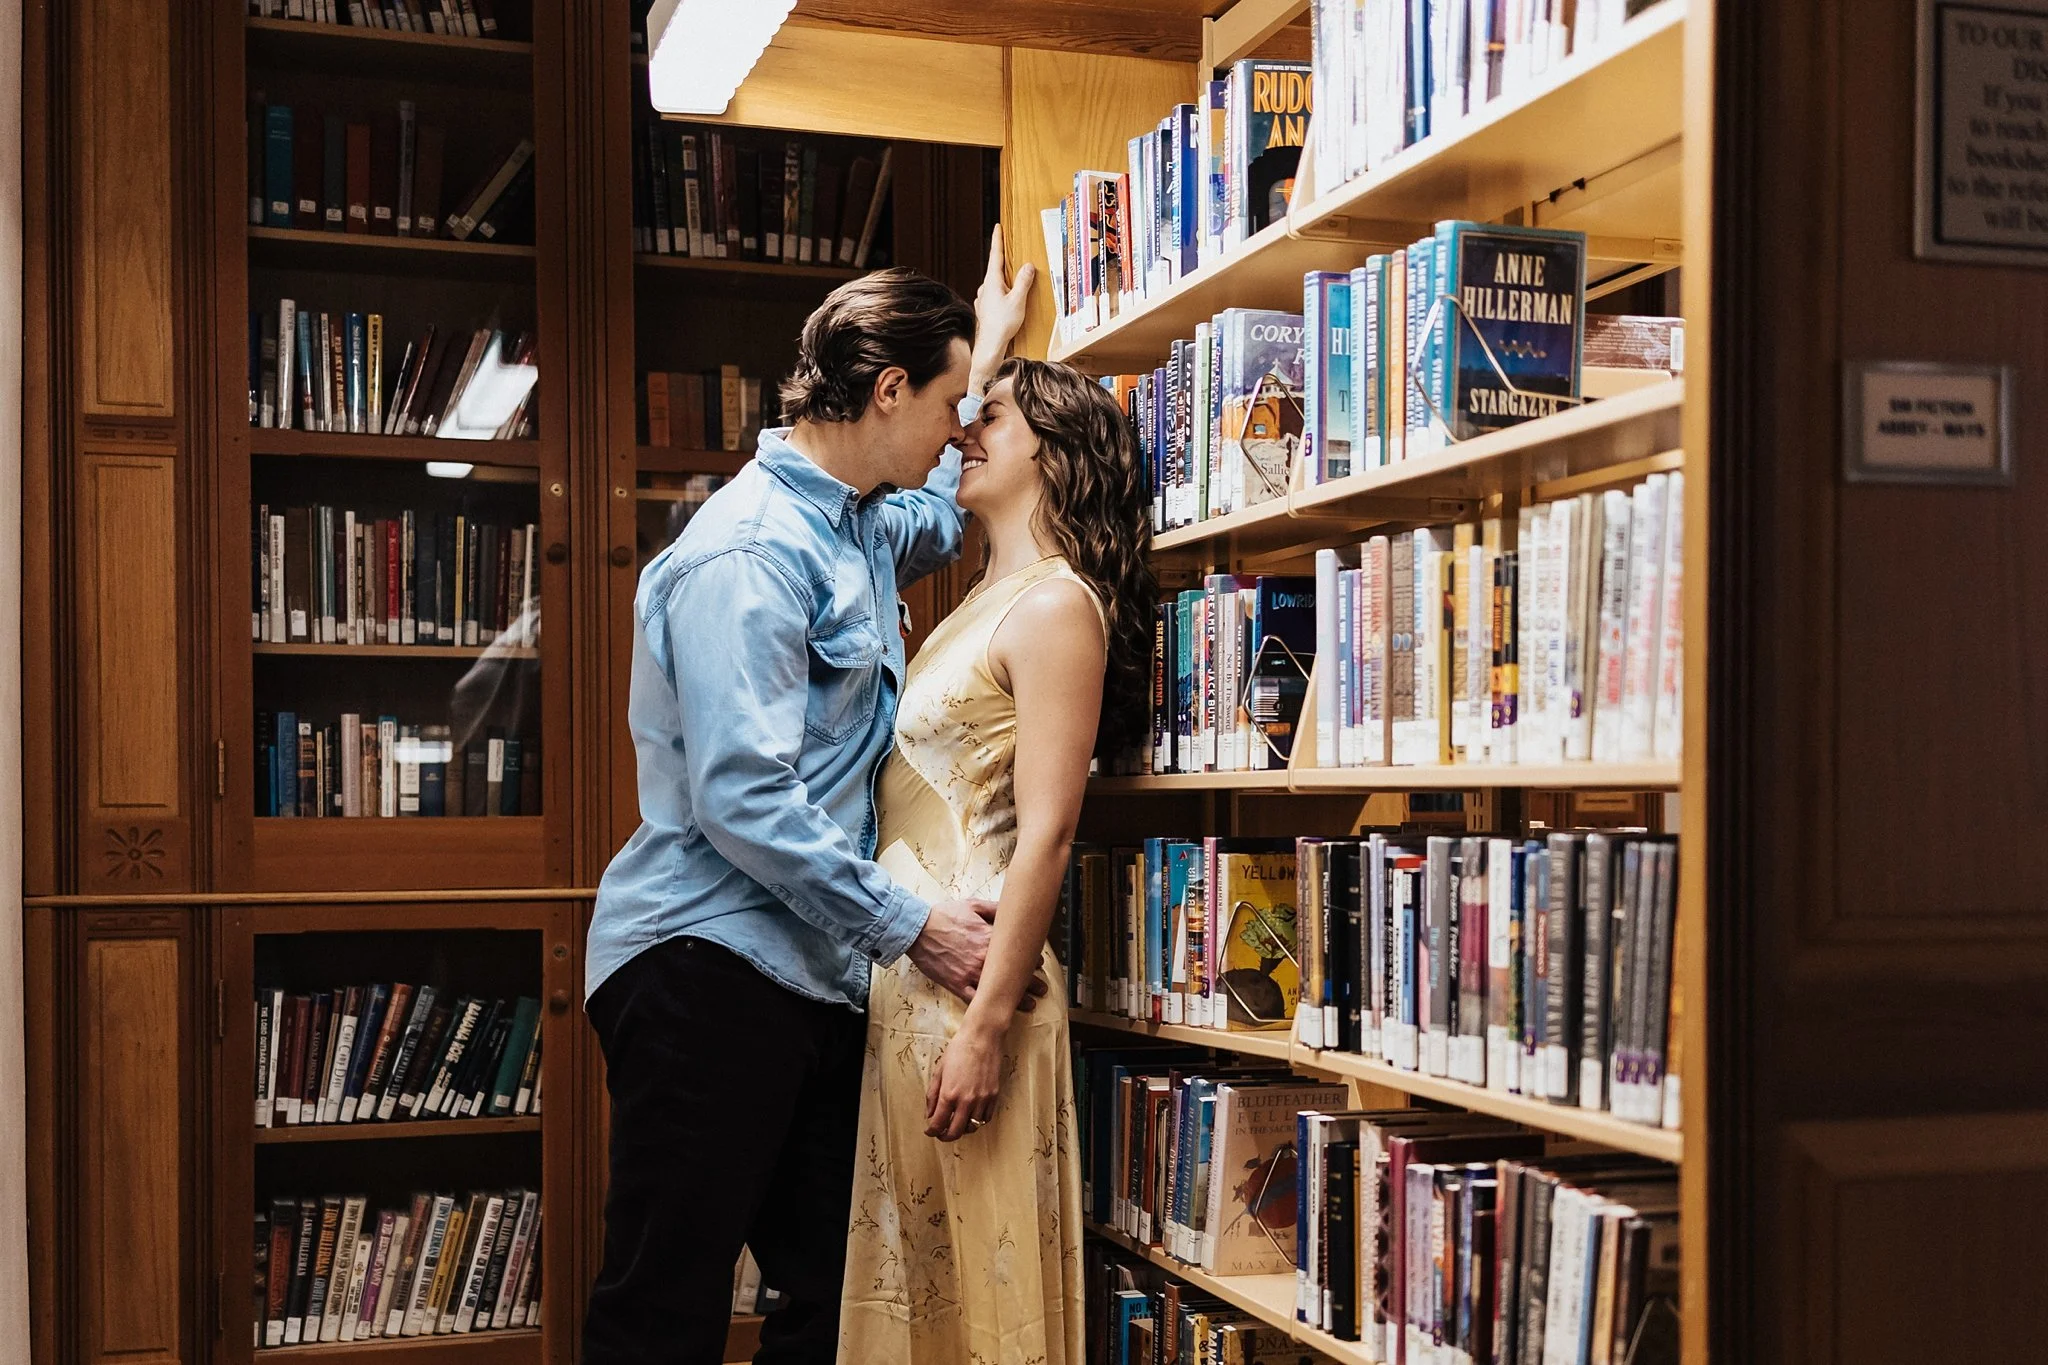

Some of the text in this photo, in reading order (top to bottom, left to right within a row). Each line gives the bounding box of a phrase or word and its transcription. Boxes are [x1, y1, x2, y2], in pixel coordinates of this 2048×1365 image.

[1956, 21, 2043, 50] TO OUR
[1973, 173, 2003, 198] the
[1494, 253, 1546, 287] ANNE
[1367, 274, 1377, 302] ANNE
[1463, 286, 1574, 325] HILLERMAN
[1367, 305, 1376, 369] HILLERMAN
[1469, 388, 1558, 418] STARGAZER
[1155, 661, 1163, 706] GROUND
[1225, 673, 1232, 684] By
[1450, 874, 1459, 921] Dream
[445, 1002, 482, 1063] BANANA ROSE
[1238, 1093, 1342, 1110] BLUEFEATHER
[1184, 1107, 1194, 1189] BLUEFEATHER
[1168, 1172, 1174, 1185] OF
[323, 1208, 338, 1228] TONY
[348, 1205, 359, 1221] TONY
[438, 1202, 450, 1218] TONY
[489, 1203, 502, 1220] TONY
[340, 1222, 357, 1258] HILLERMAN
[428, 1220, 448, 1256] HILLERMAN
[479, 1221, 498, 1255] HILLERMAN
[495, 1199, 519, 1256] TONY HILLERMAN
[297, 1218, 313, 1276] ANNE HILLERMAN
[315, 1230, 336, 1276] HILLERMAN
[370, 1267, 382, 1286] WAY
[1231, 1260, 1266, 1271] MAX
